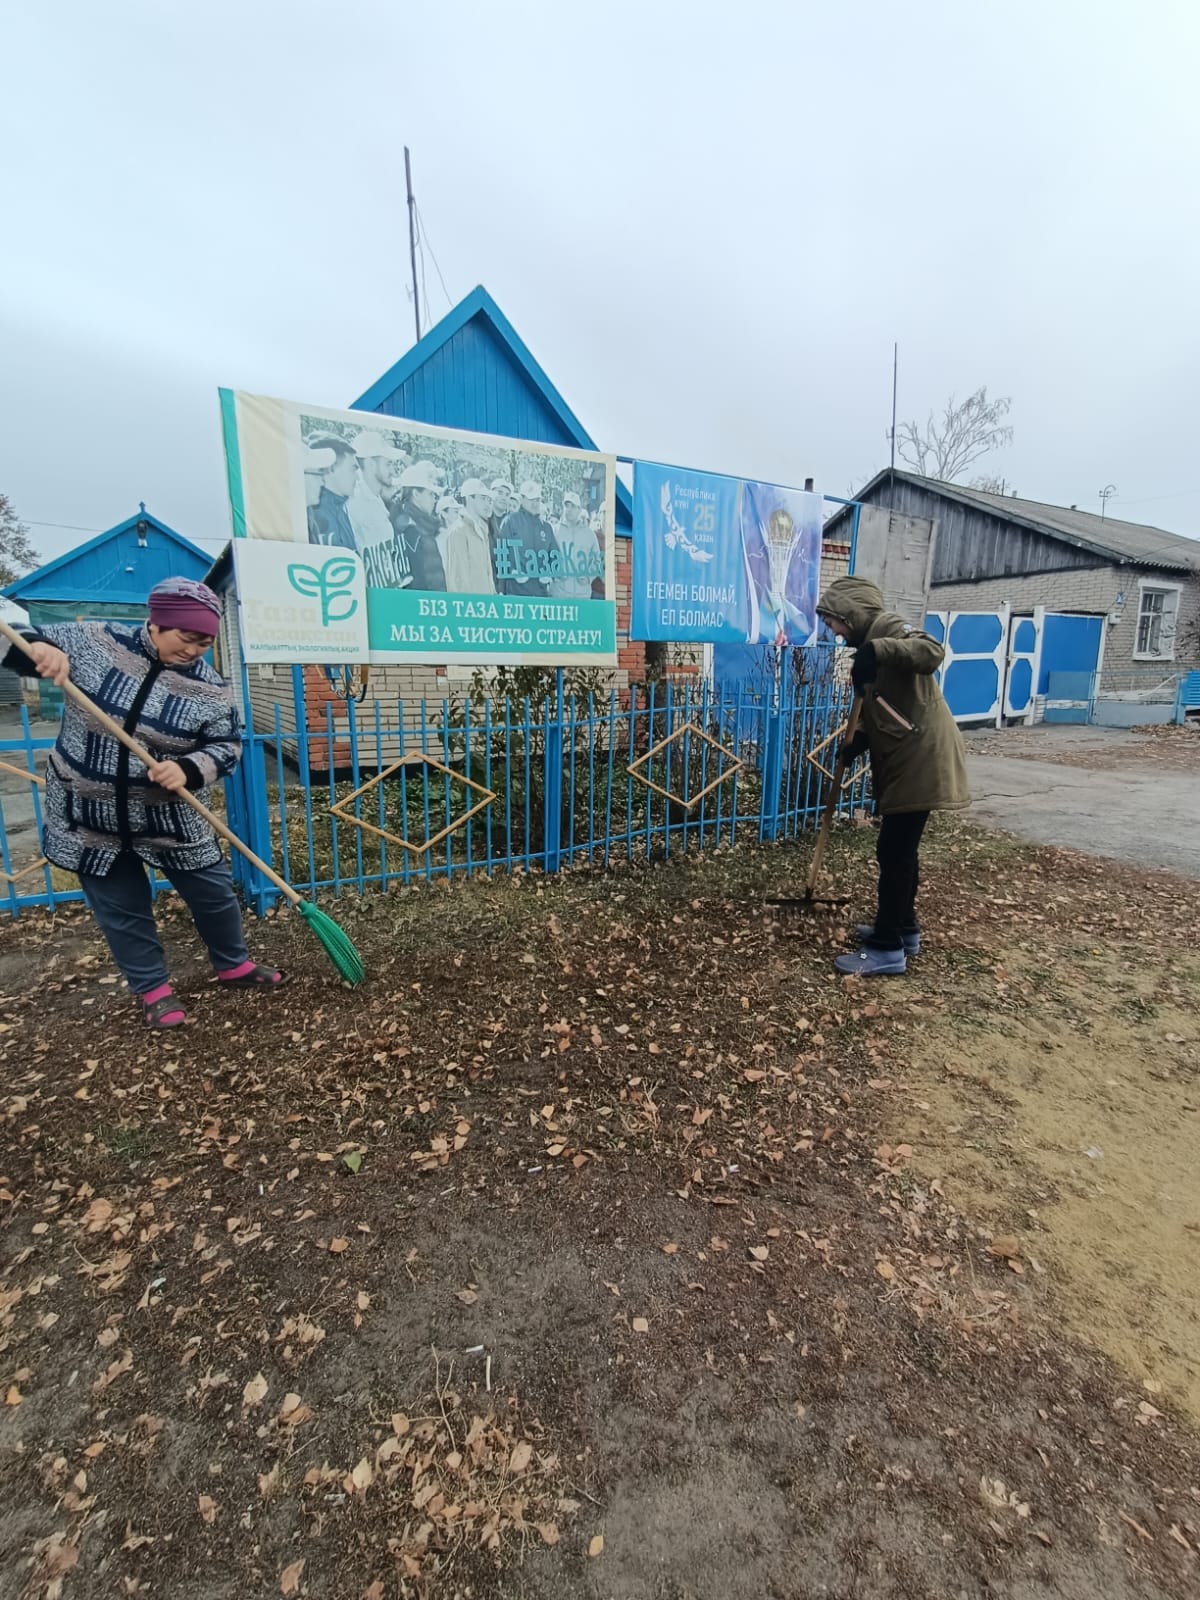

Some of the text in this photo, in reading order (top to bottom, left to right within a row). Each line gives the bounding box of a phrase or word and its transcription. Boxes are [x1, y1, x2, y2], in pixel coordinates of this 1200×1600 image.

[693, 503, 716, 532] 25
[646, 581, 737, 606] ЕГЕМЕН БОЛМАЙ,
[244, 598, 318, 623] Таза
[418, 599, 448, 617] БІЗ
[452, 600, 499, 619] ТАЗА
[503, 603, 524, 620] ЕЛ
[661, 608, 724, 628] ЕЛ БОЛМАС
[390, 624, 603, 647] МЫ ЗА ЧИСТУЮ СТРАНУ!
